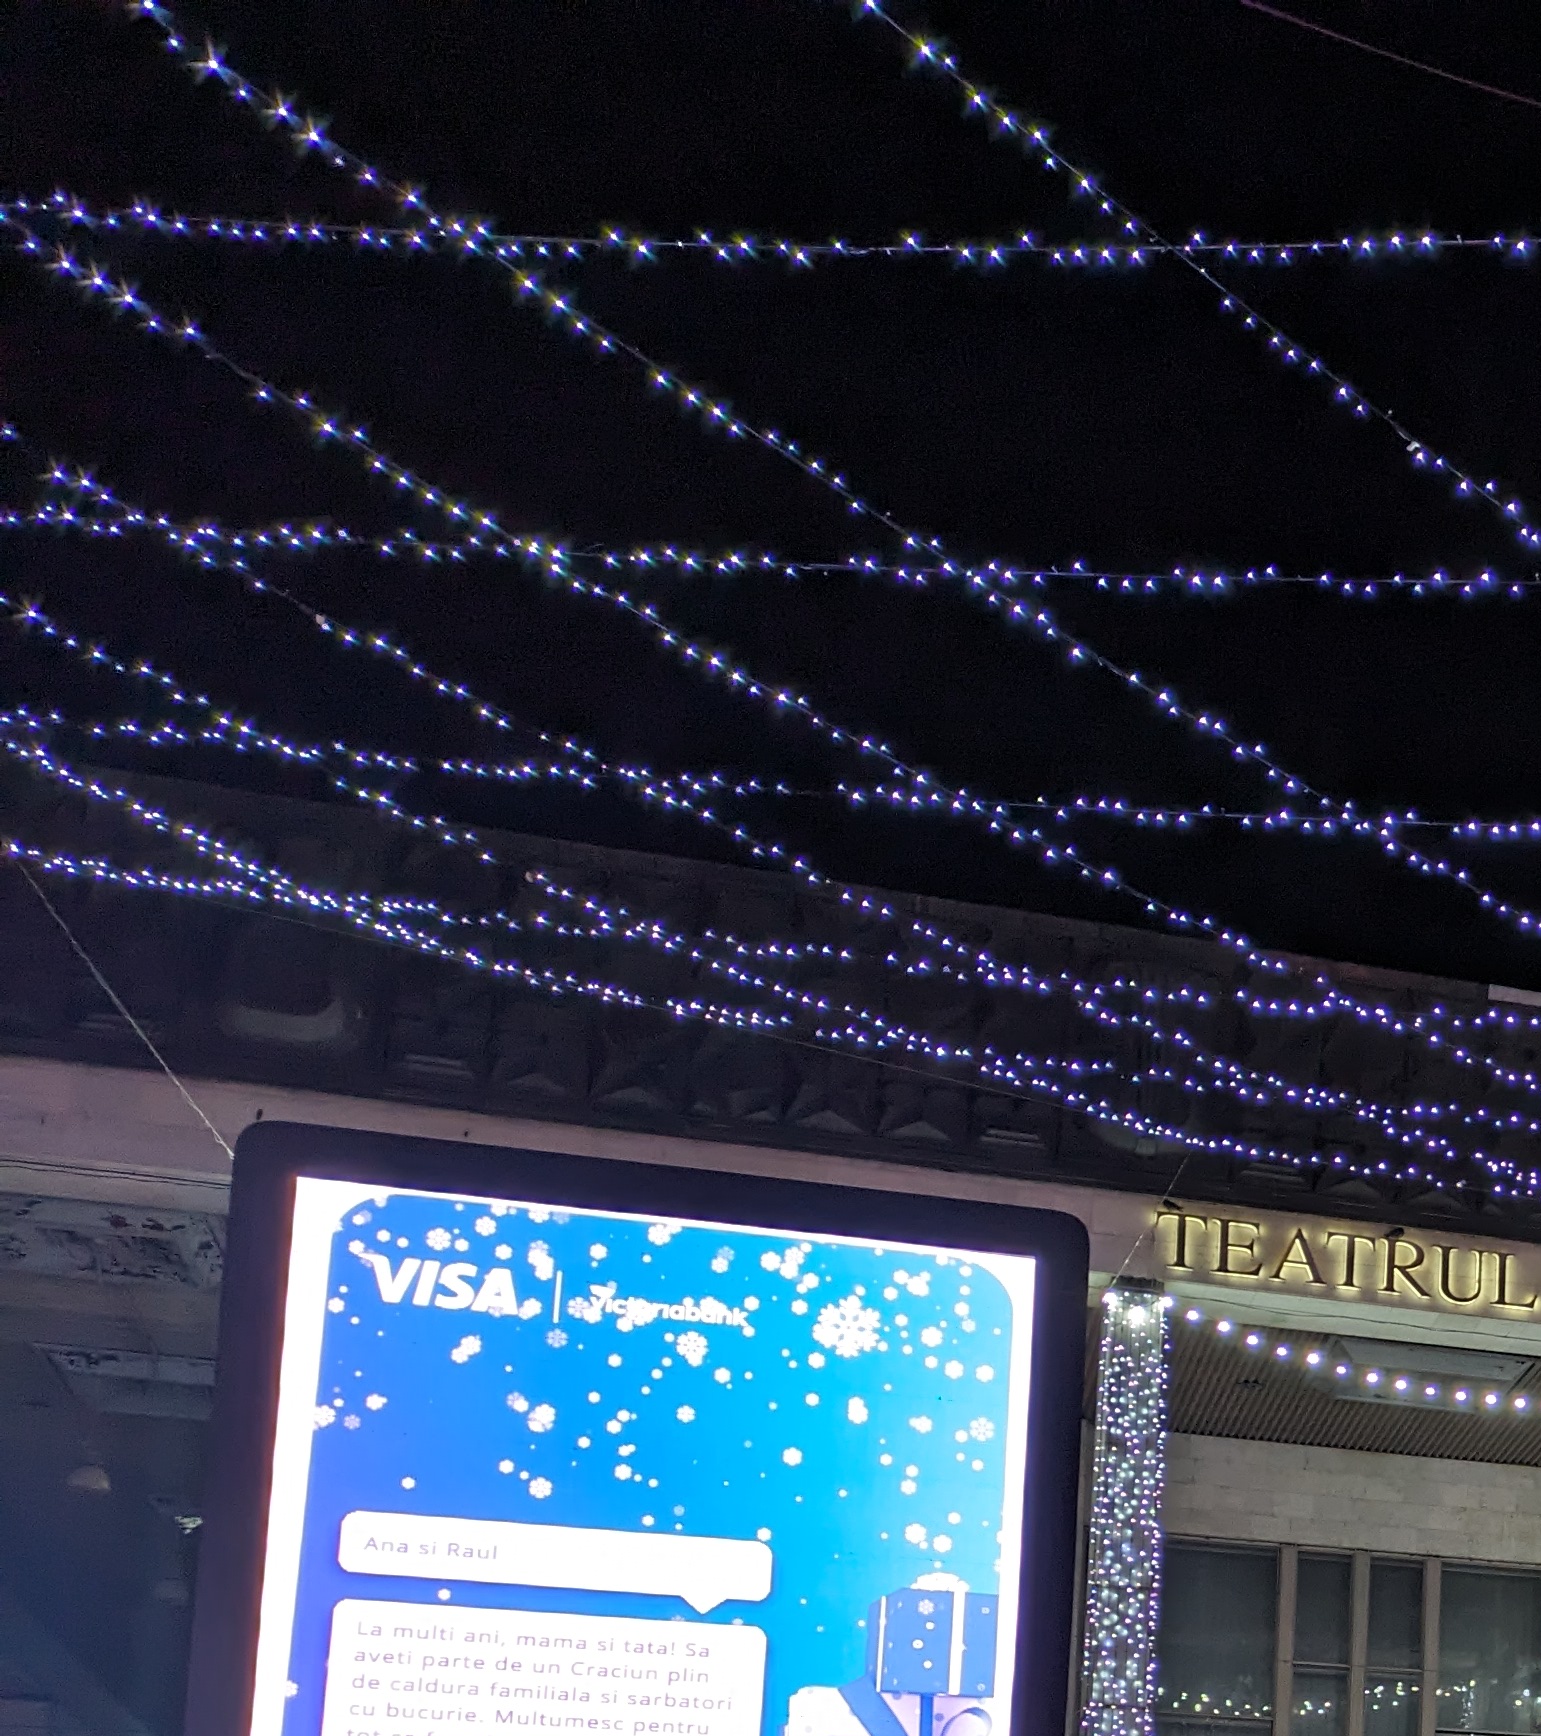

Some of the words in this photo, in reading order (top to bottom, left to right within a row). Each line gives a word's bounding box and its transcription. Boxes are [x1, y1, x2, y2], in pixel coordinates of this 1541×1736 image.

[1156, 1212, 1537, 1310] TEATRUL
[363, 1252, 519, 1316] VISA
[364, 1537, 409, 1554] Ana
[419, 1540, 438, 1556] si
[447, 1542, 498, 1560] Raul
[357, 1621, 383, 1637] La
[393, 1624, 454, 1641] multi
[463, 1629, 506, 1647] ani,
[517, 1633, 587, 1650] mama
[597, 1635, 615, 1652] si
[624, 1639, 676, 1657] tata!
[685, 1642, 711, 1658] Sa
[354, 1649, 412, 1666] aveti
[422, 1653, 485, 1673] parte
[495, 1657, 522, 1673] de
[533, 1661, 561, 1676] un
[570, 1661, 658, 1681] Craciun
[668, 1667, 710, 1688] plin
[351, 1675, 380, 1691] de
[390, 1677, 480, 1697] caldura
[490, 1682, 591, 1704] familiala
[601, 1689, 619, 1705] si
[627, 1692, 733, 1712] sarbatori
[349, 1703, 375, 1717] cu
[387, 1703, 484, 1724] bucurie.
[495, 1709, 624, 1731] Multumesc
